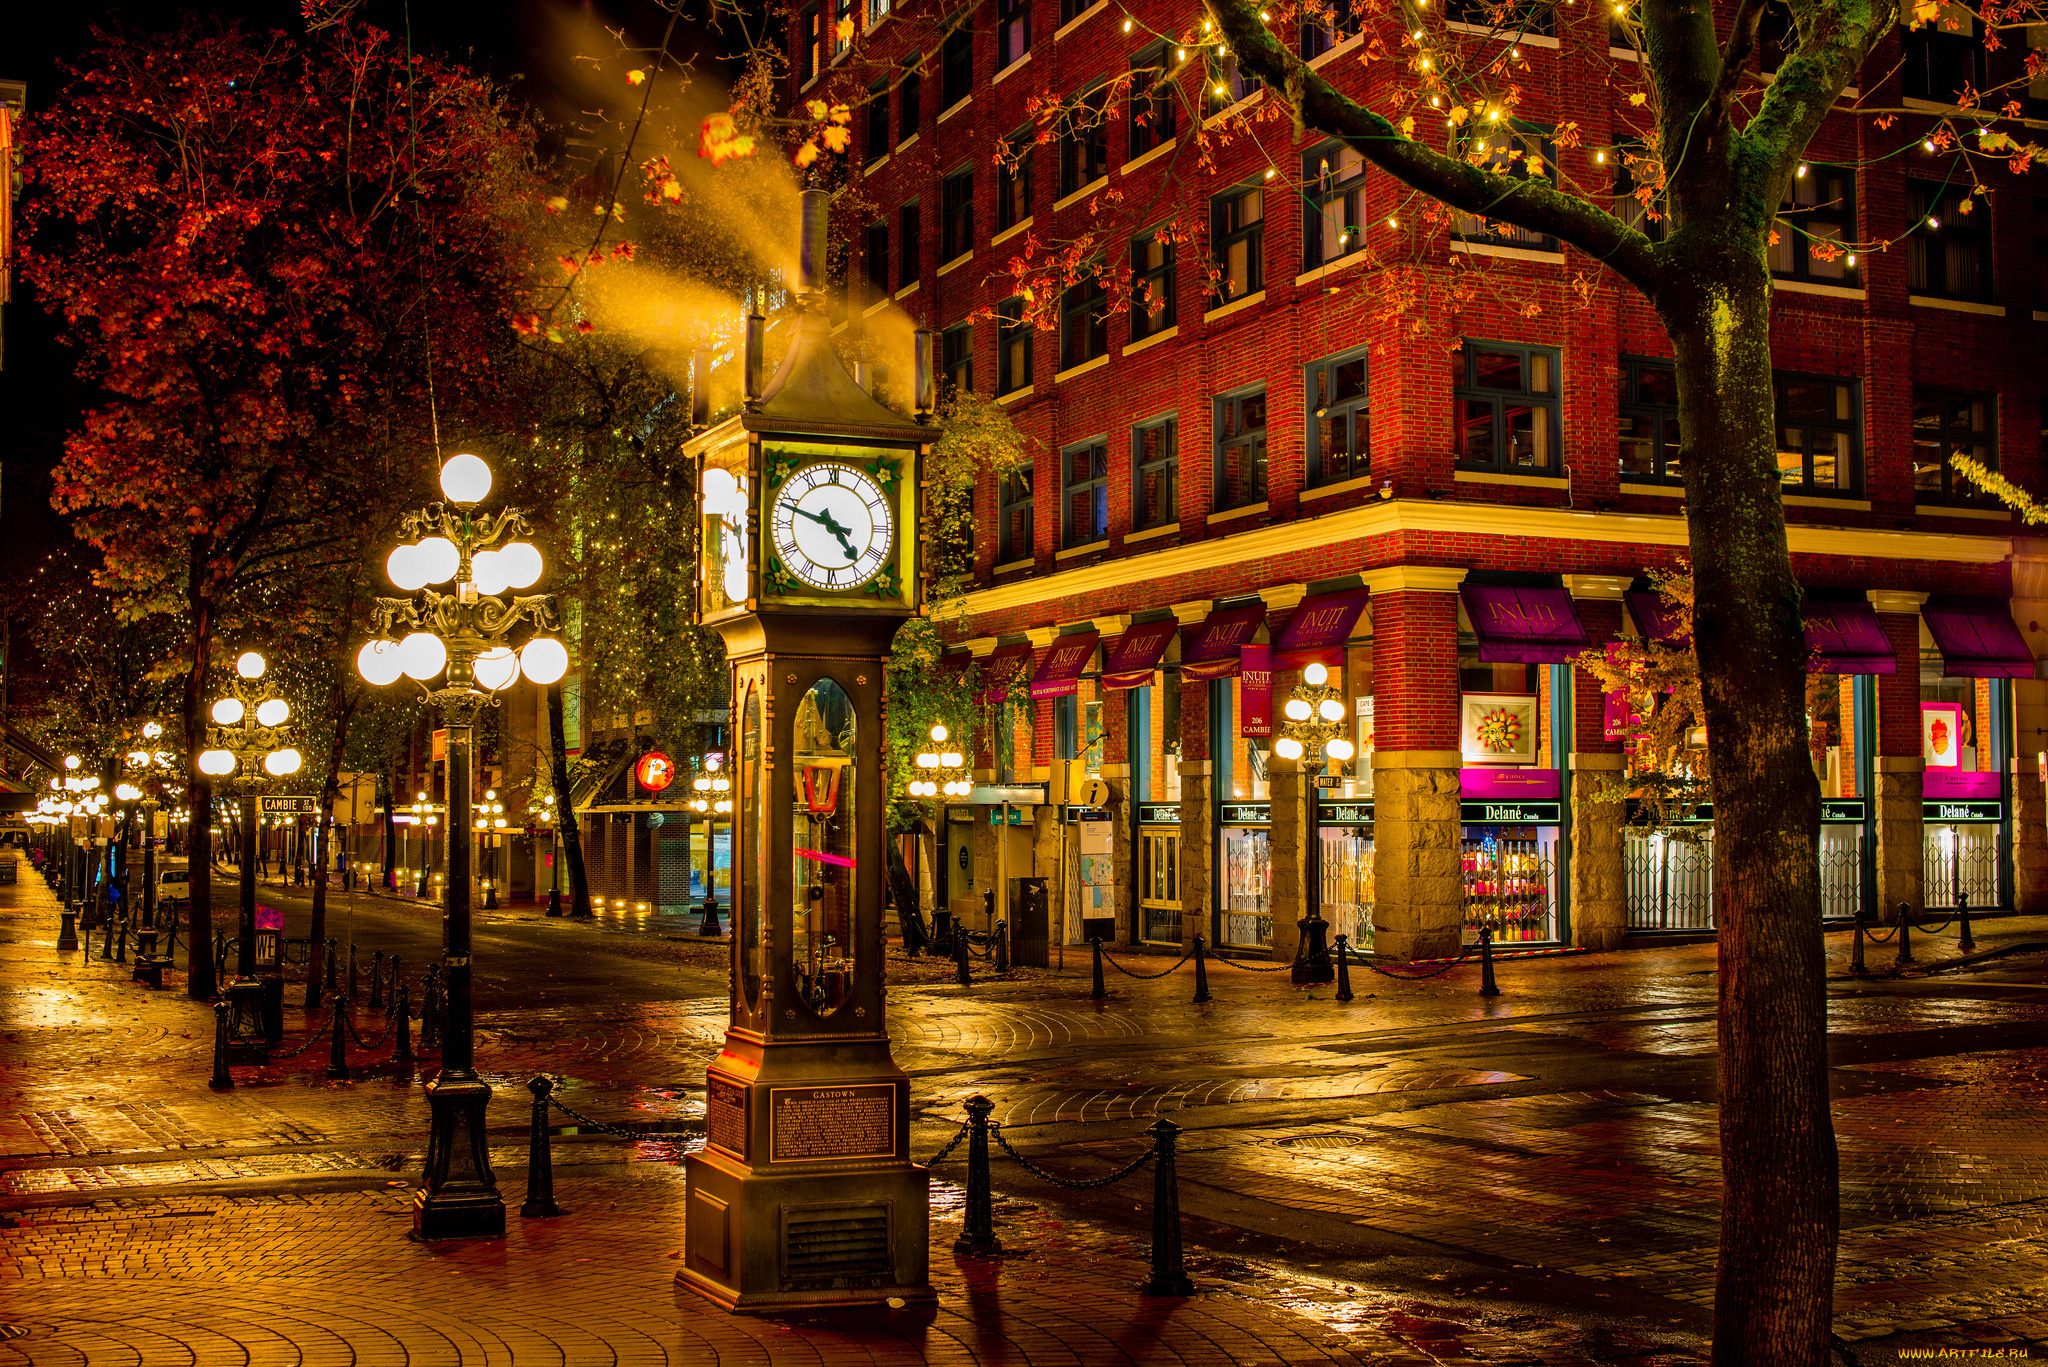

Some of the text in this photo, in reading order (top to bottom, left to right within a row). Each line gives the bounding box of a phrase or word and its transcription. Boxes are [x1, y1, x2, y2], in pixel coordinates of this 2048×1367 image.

[1300, 605, 1348, 629] INUIT
[1488, 602, 1556, 620] INUIT
[1205, 621, 1248, 642] INUIT
[1945, 622, 2002, 640] INUIT
[1124, 635, 1162, 654] INUIT
[1051, 645, 1086, 664] INUIT
[1242, 671, 1271, 681] INUIT
[1252, 717, 1263, 725] 206
[1243, 726, 1271, 734] CAMBIE
[647, 758, 666, 784] P
[264, 799, 297, 810] CAMBIE
[1238, 806, 1258, 820] Delané
[1336, 805, 1358, 821] Delané
[1485, 805, 1521, 820] Delané
[1940, 804, 1970, 818] Delané
[257, 935, 275, 958] WE
